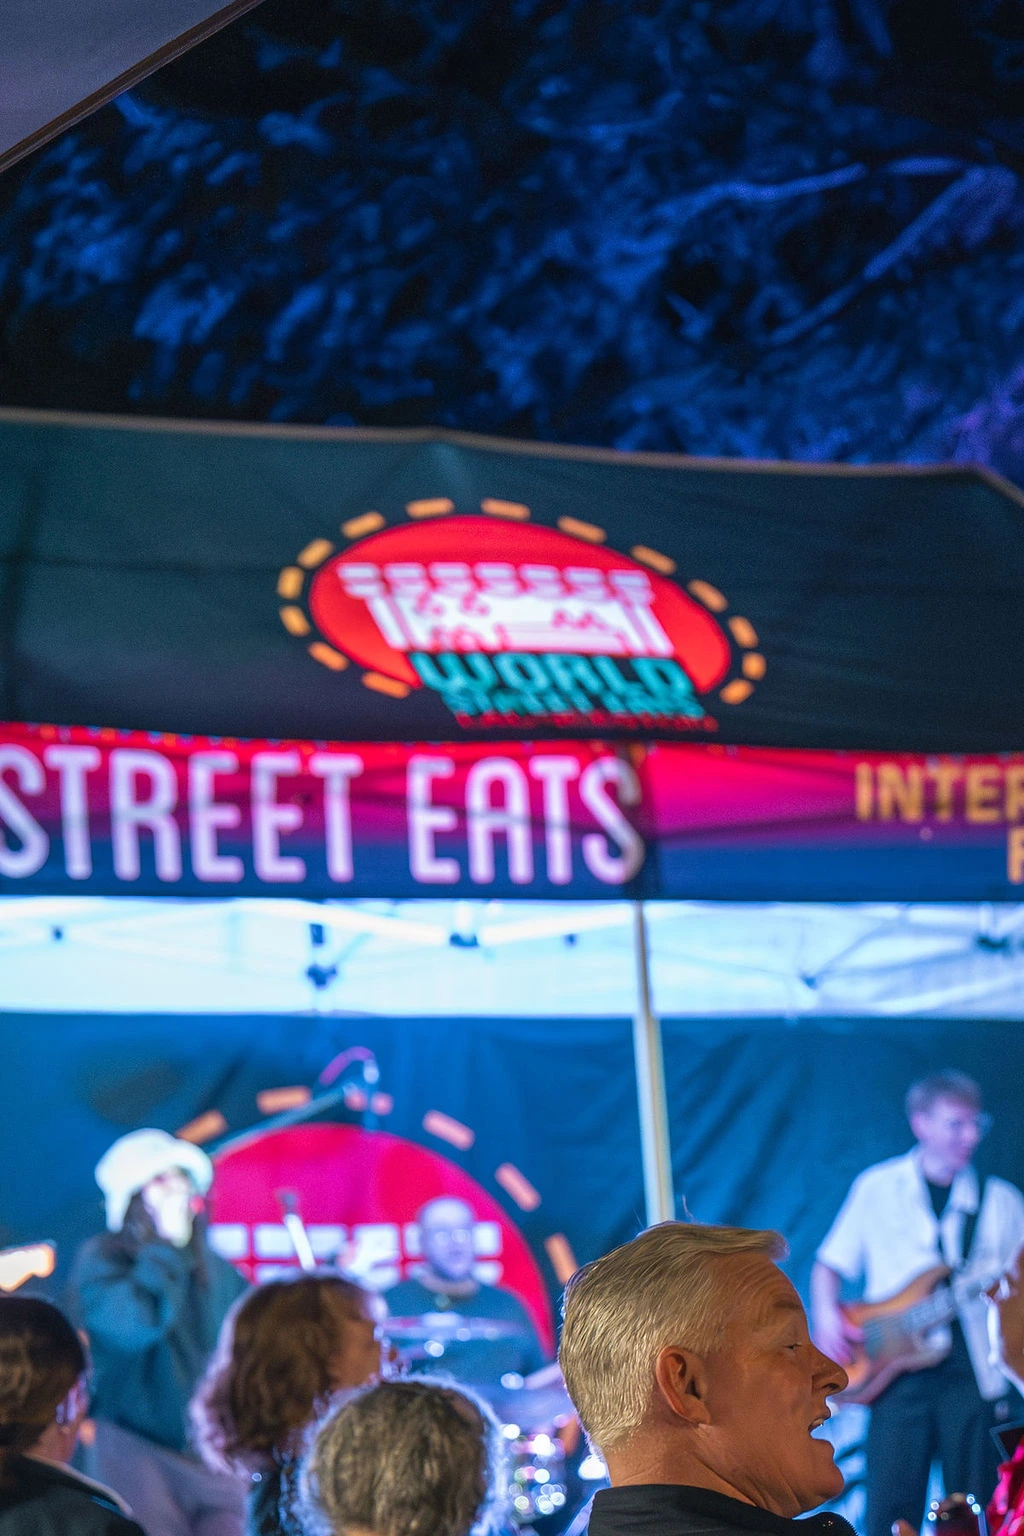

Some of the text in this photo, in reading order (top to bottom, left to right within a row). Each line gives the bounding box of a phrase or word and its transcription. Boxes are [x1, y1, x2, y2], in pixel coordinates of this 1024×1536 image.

[408, 651, 698, 696] WORLD
[0, 743, 645, 885] STREET EATS
